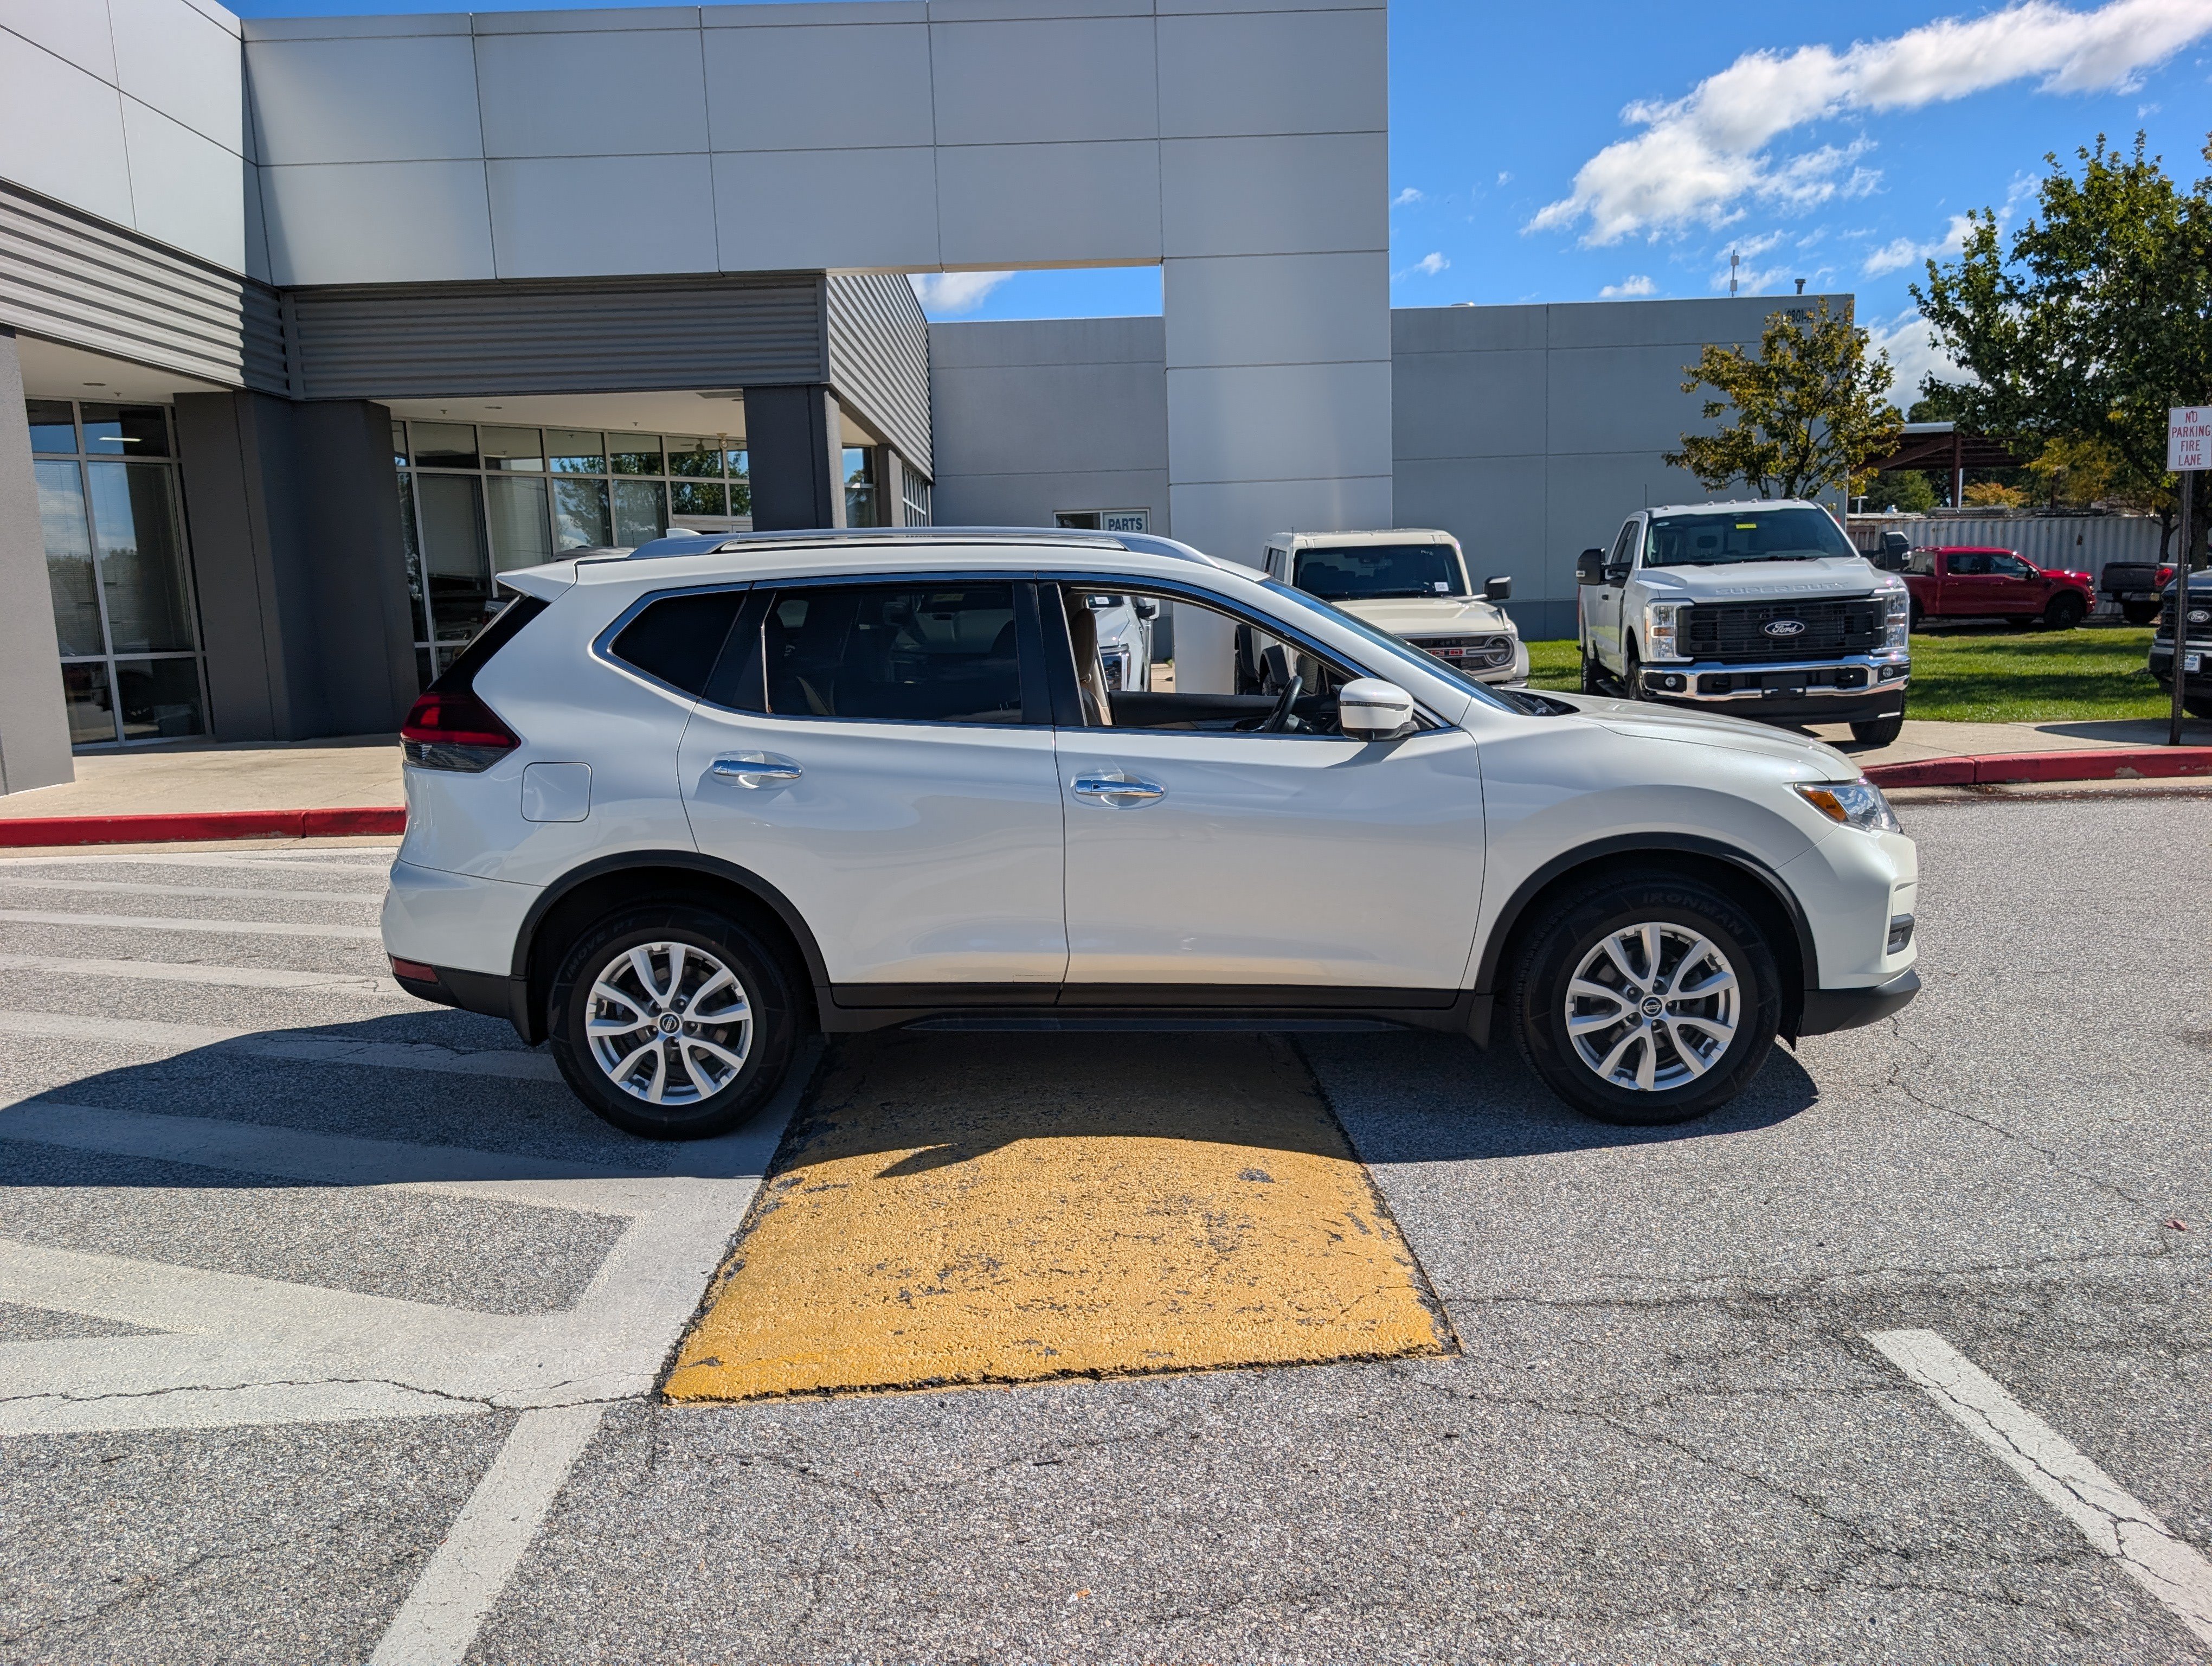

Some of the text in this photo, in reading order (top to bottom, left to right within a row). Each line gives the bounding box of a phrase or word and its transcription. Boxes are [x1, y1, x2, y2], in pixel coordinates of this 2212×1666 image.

[2185, 411, 2198, 424] NO
[2171, 425, 2211, 438] PARKING
[2181, 440, 2201, 452] FIRE
[2178, 454, 2202, 466] LANE
[1108, 517, 1142, 531] PARTS
[1715, 582, 1849, 595] SUPER DUTY
[2190, 612, 2205, 621] Ford
[1771, 623, 1798, 633] Ford
